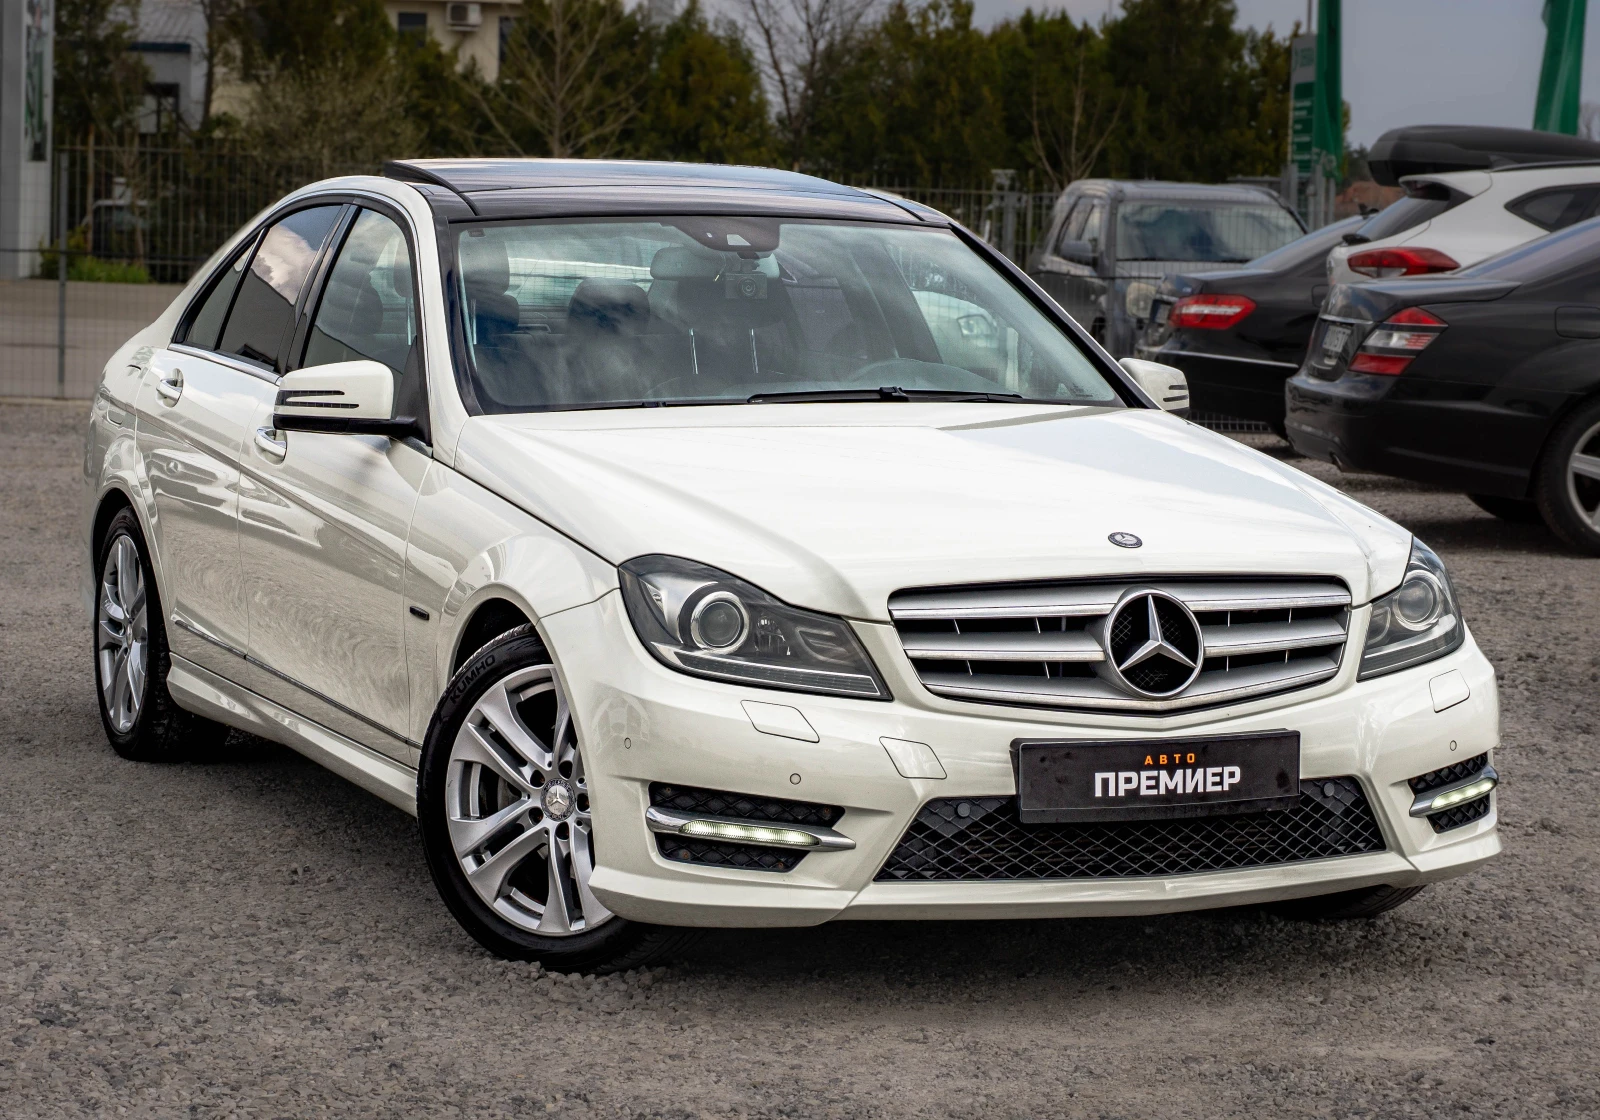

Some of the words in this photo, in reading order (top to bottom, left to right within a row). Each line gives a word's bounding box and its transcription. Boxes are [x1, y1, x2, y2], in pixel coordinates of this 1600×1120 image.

[449, 654, 496, 704] KUMHO
[1144, 753, 1195, 766] АВТО
[1094, 765, 1241, 797] ПРЕМИЕР
